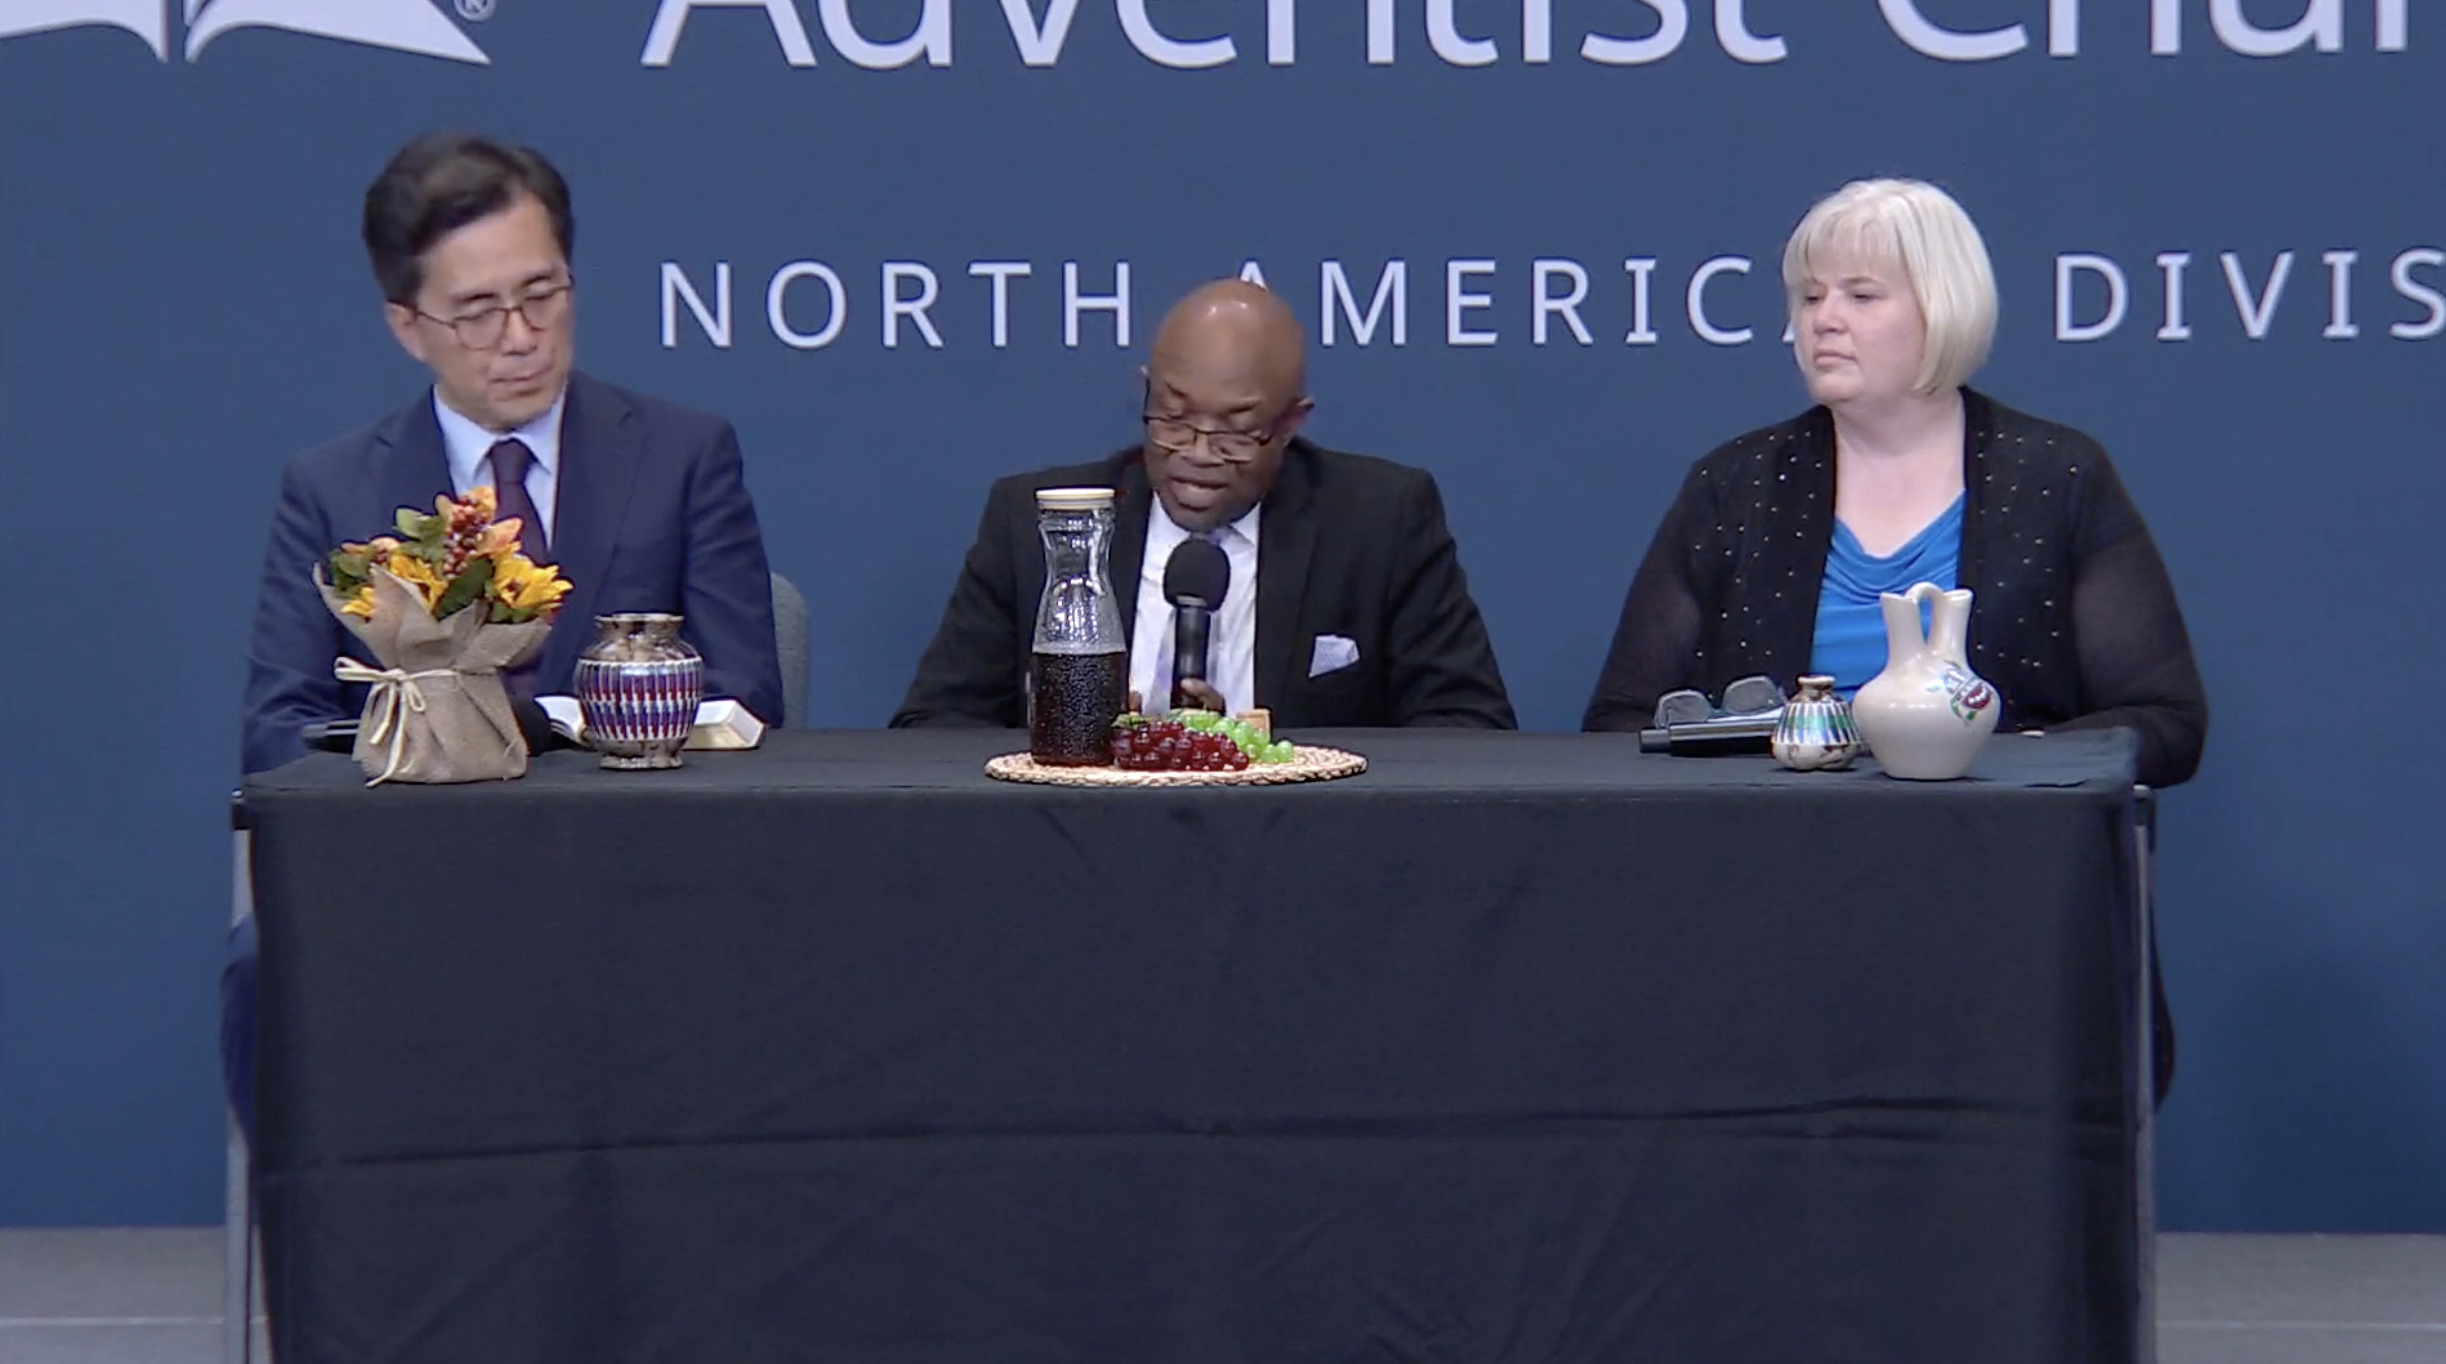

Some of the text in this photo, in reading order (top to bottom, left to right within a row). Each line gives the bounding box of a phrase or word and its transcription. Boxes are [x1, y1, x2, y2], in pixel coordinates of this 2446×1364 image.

[661, 249, 2446, 348] NORTH MERIC DIVIS
